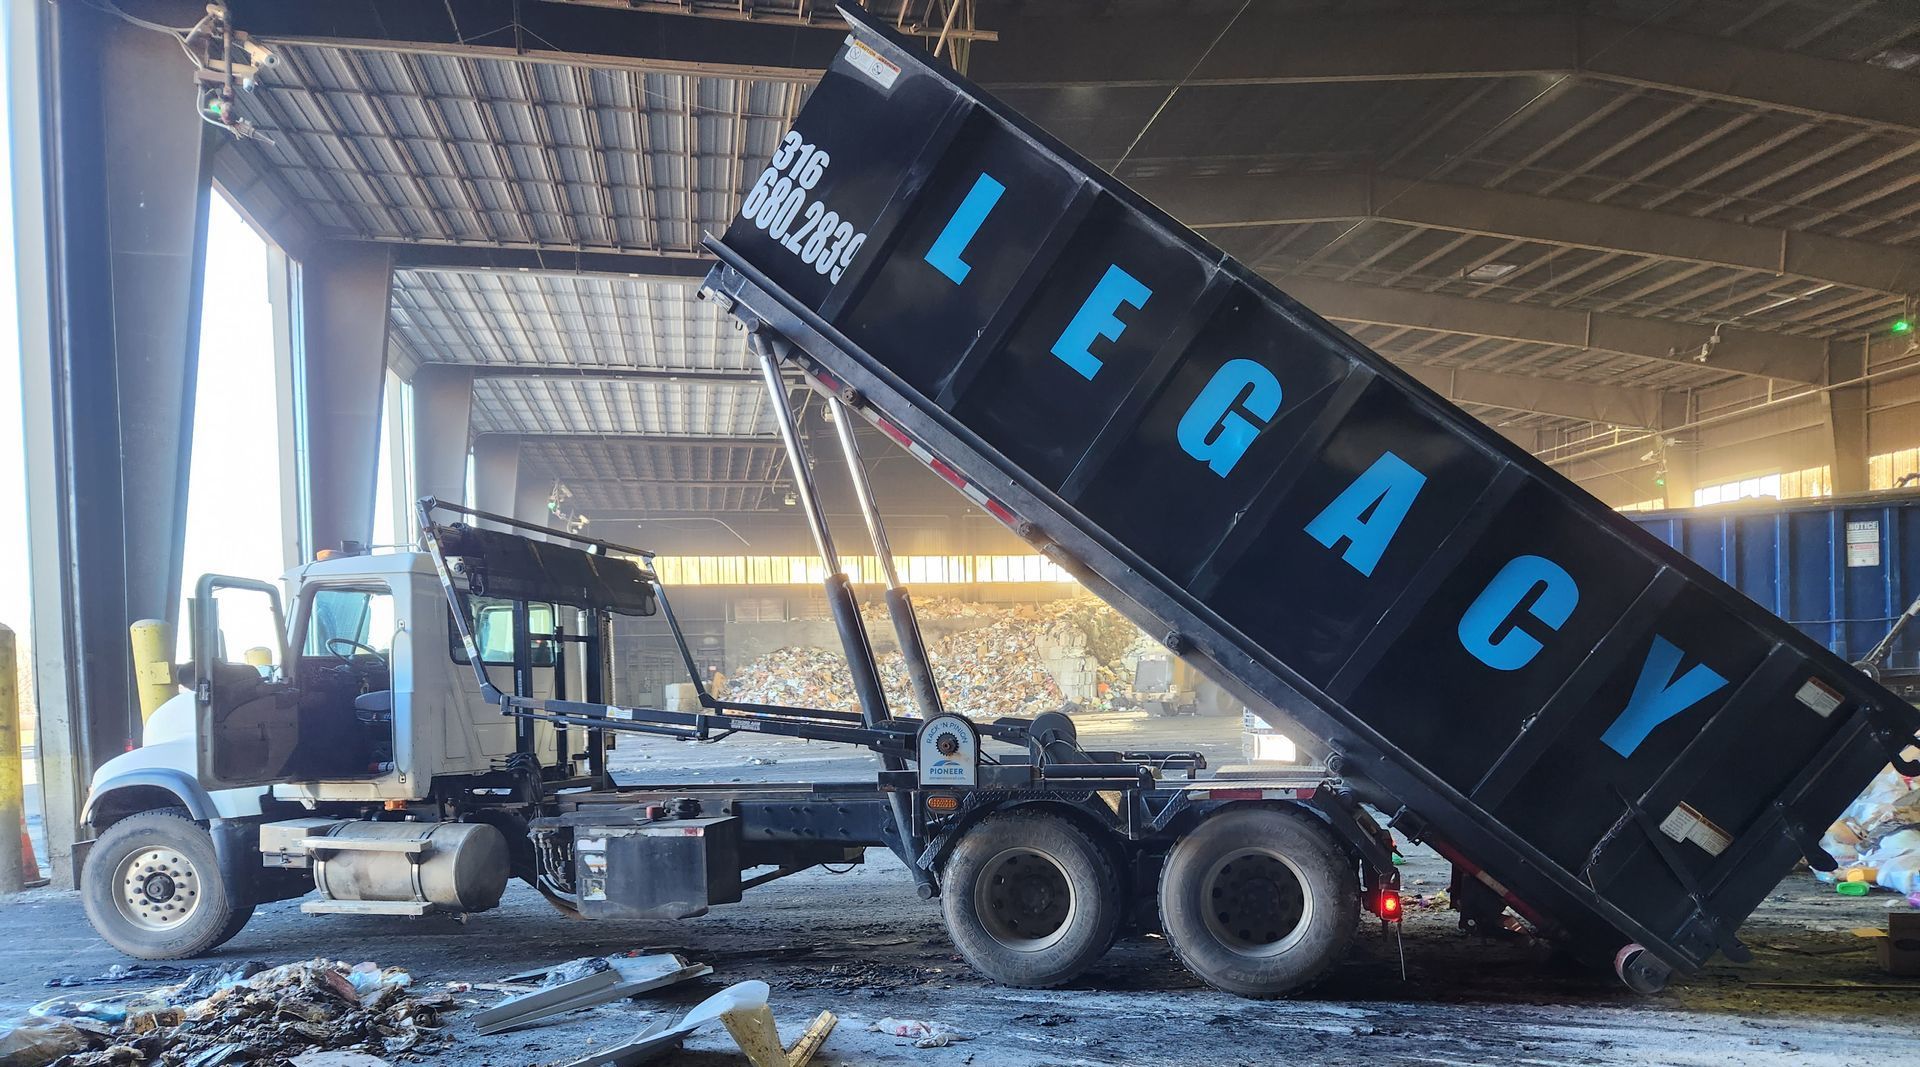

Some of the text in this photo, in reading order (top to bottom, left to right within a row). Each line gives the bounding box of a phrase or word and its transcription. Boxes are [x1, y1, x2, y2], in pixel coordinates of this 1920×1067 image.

[772, 131, 830, 189] 316
[742, 167, 867, 285] 680.2839
[924, 172, 1728, 757] LEGACY
[1847, 521, 1878, 530] NOTICE
[926, 724, 940, 744] RACK
[949, 722, 968, 743] PINION
